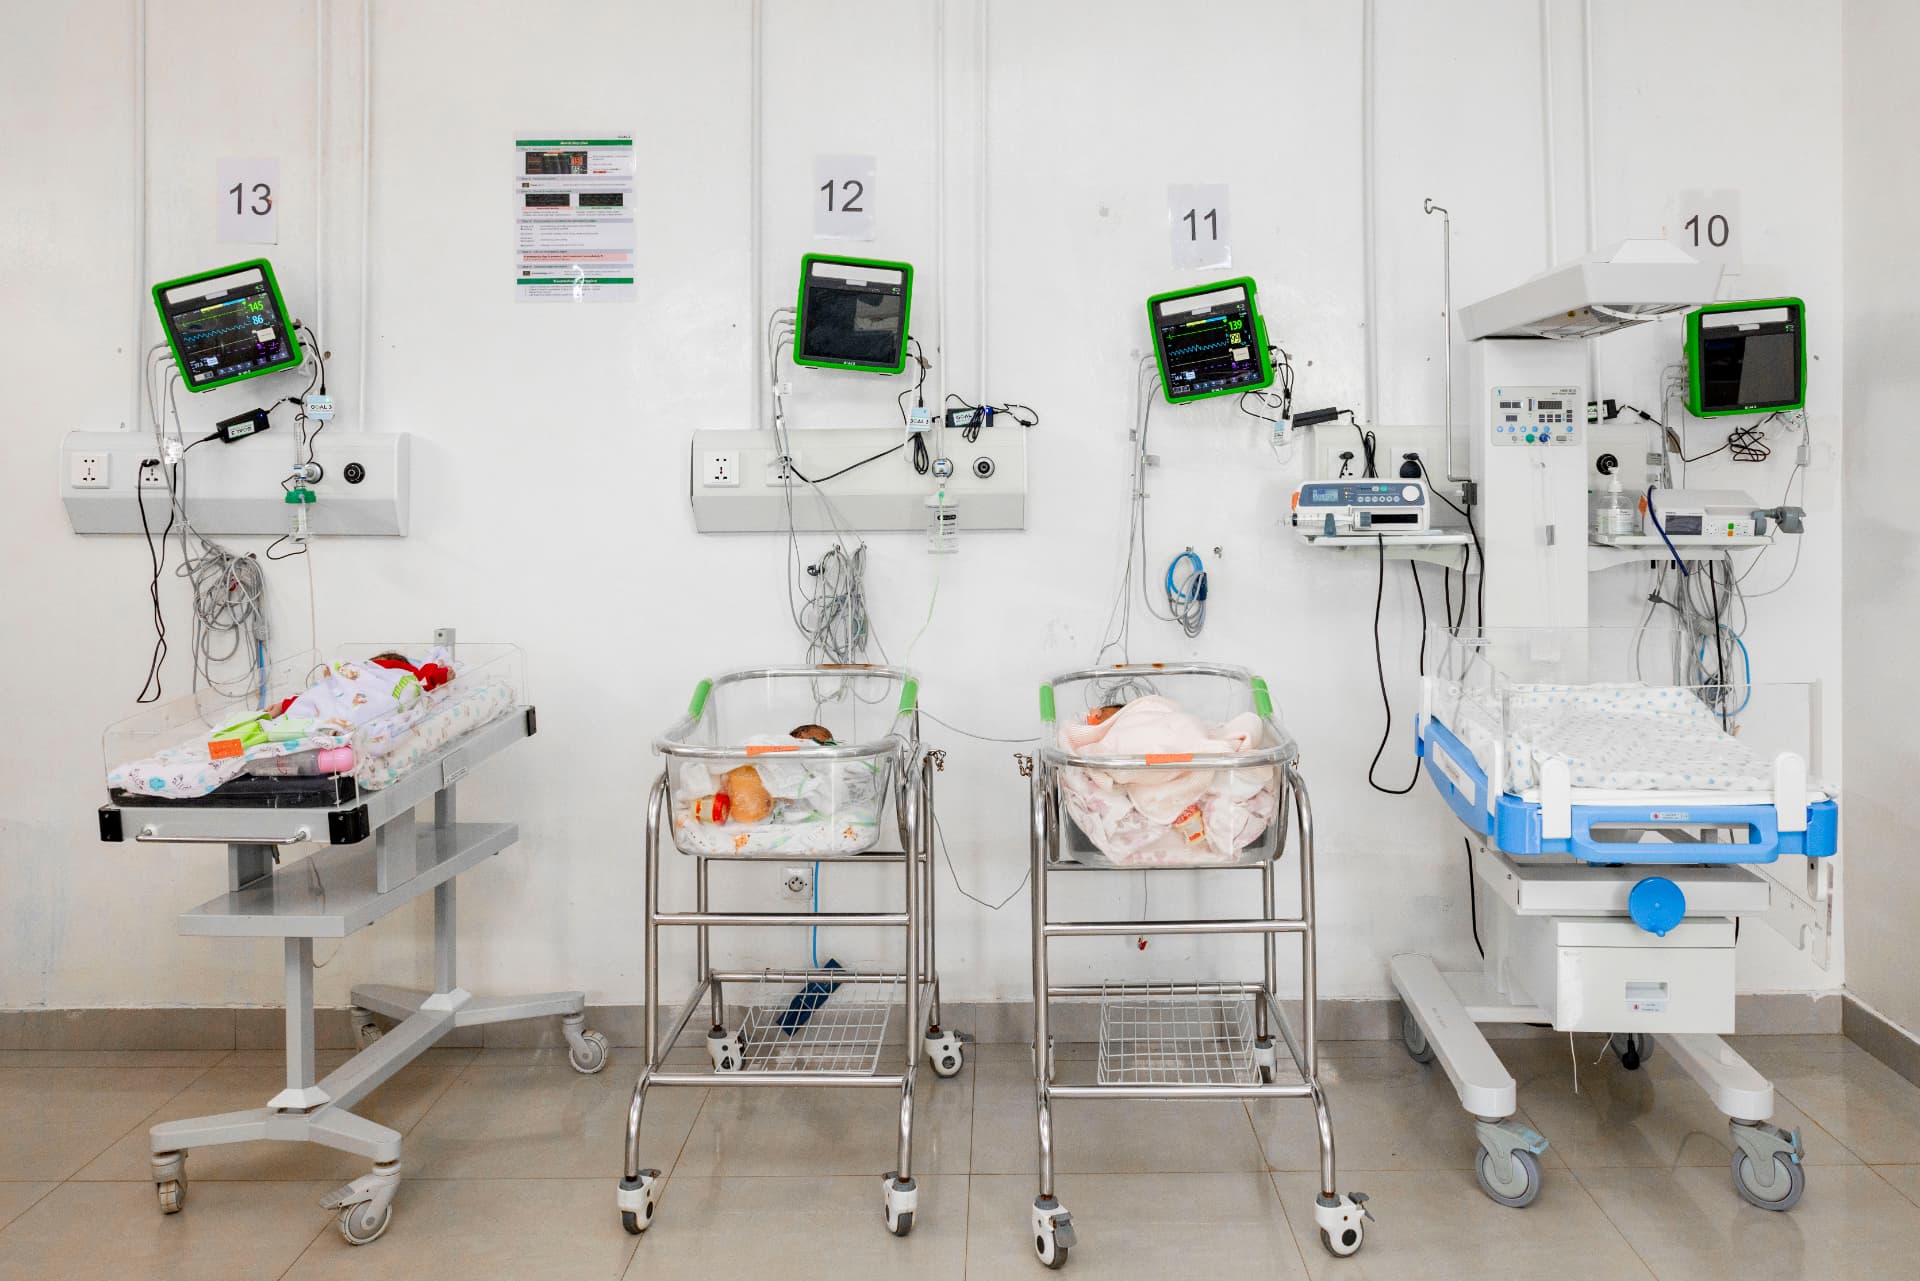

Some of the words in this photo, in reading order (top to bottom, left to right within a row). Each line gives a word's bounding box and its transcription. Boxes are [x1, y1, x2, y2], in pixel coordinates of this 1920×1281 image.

[229, 182, 272, 216] 13
[820, 179, 865, 212] 12
[1183, 208, 1217, 241] 11
[1684, 214, 1729, 247] 10
[248, 301, 264, 313] 145
[252, 314, 264, 325] 86
[1228, 319, 1243, 331] 139
